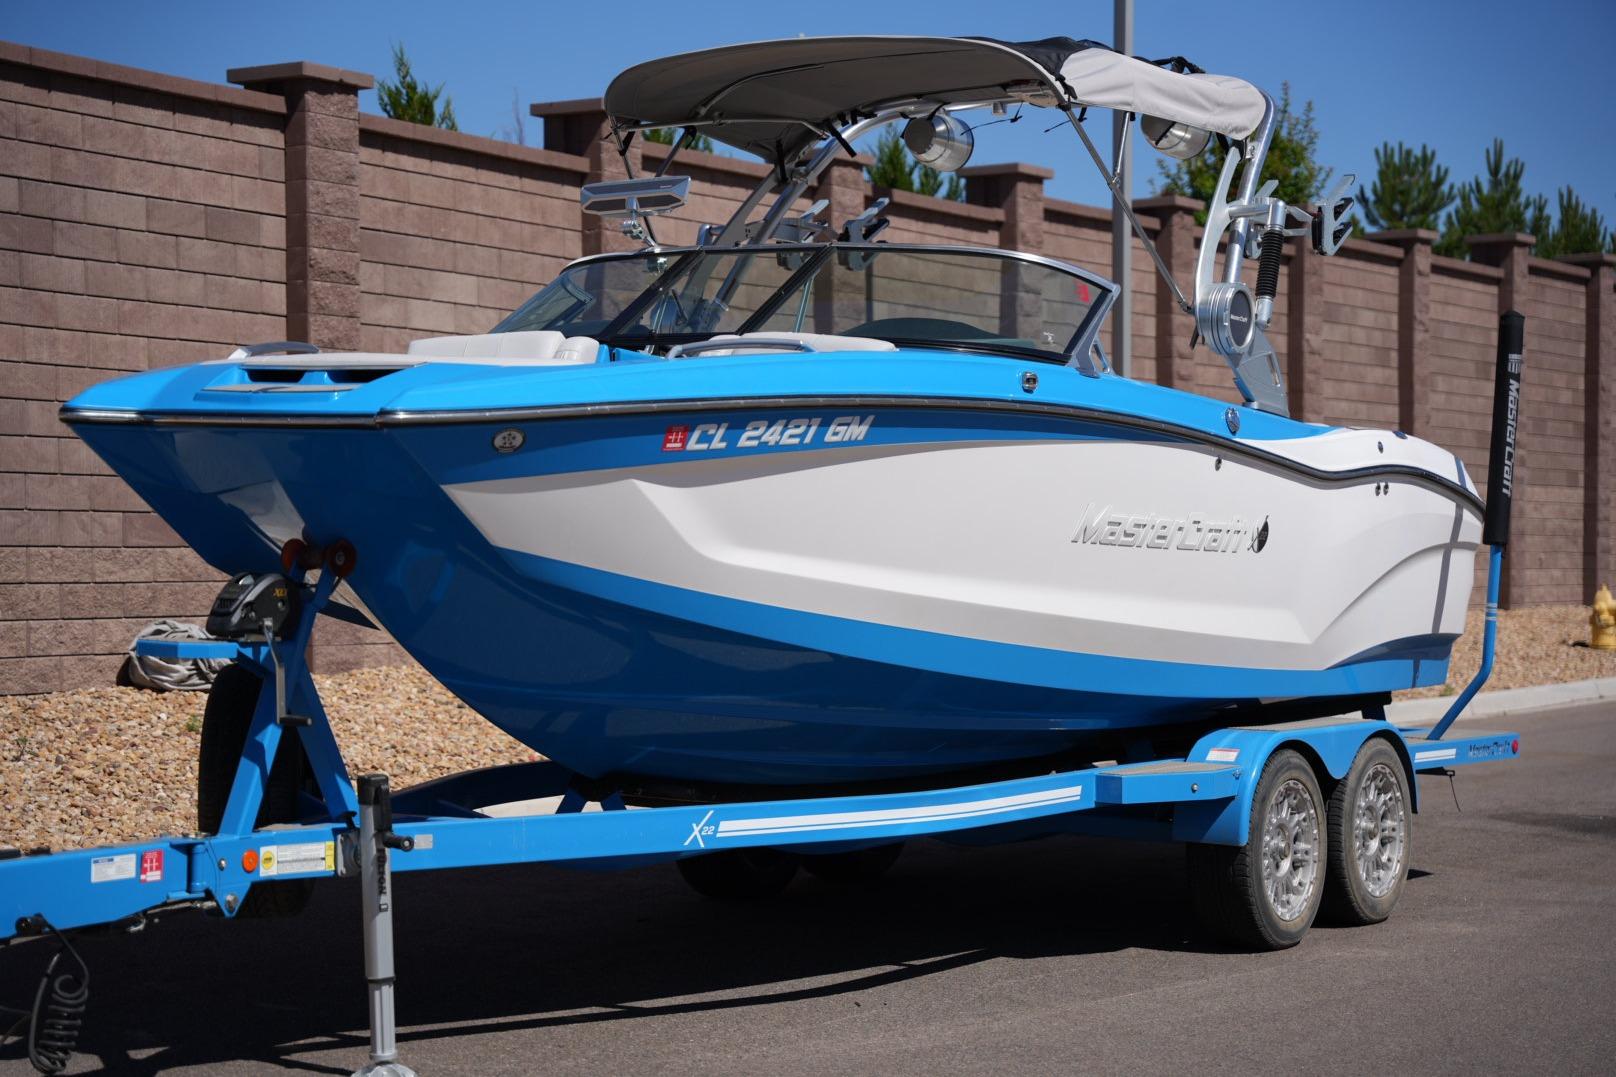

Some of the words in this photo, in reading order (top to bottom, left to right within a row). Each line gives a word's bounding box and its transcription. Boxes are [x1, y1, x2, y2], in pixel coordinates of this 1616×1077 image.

[686, 423, 729, 450] CL
[736, 417, 822, 447] 2421
[824, 415, 875, 442] GM
[1502, 378, 1520, 497] MasterCraft
